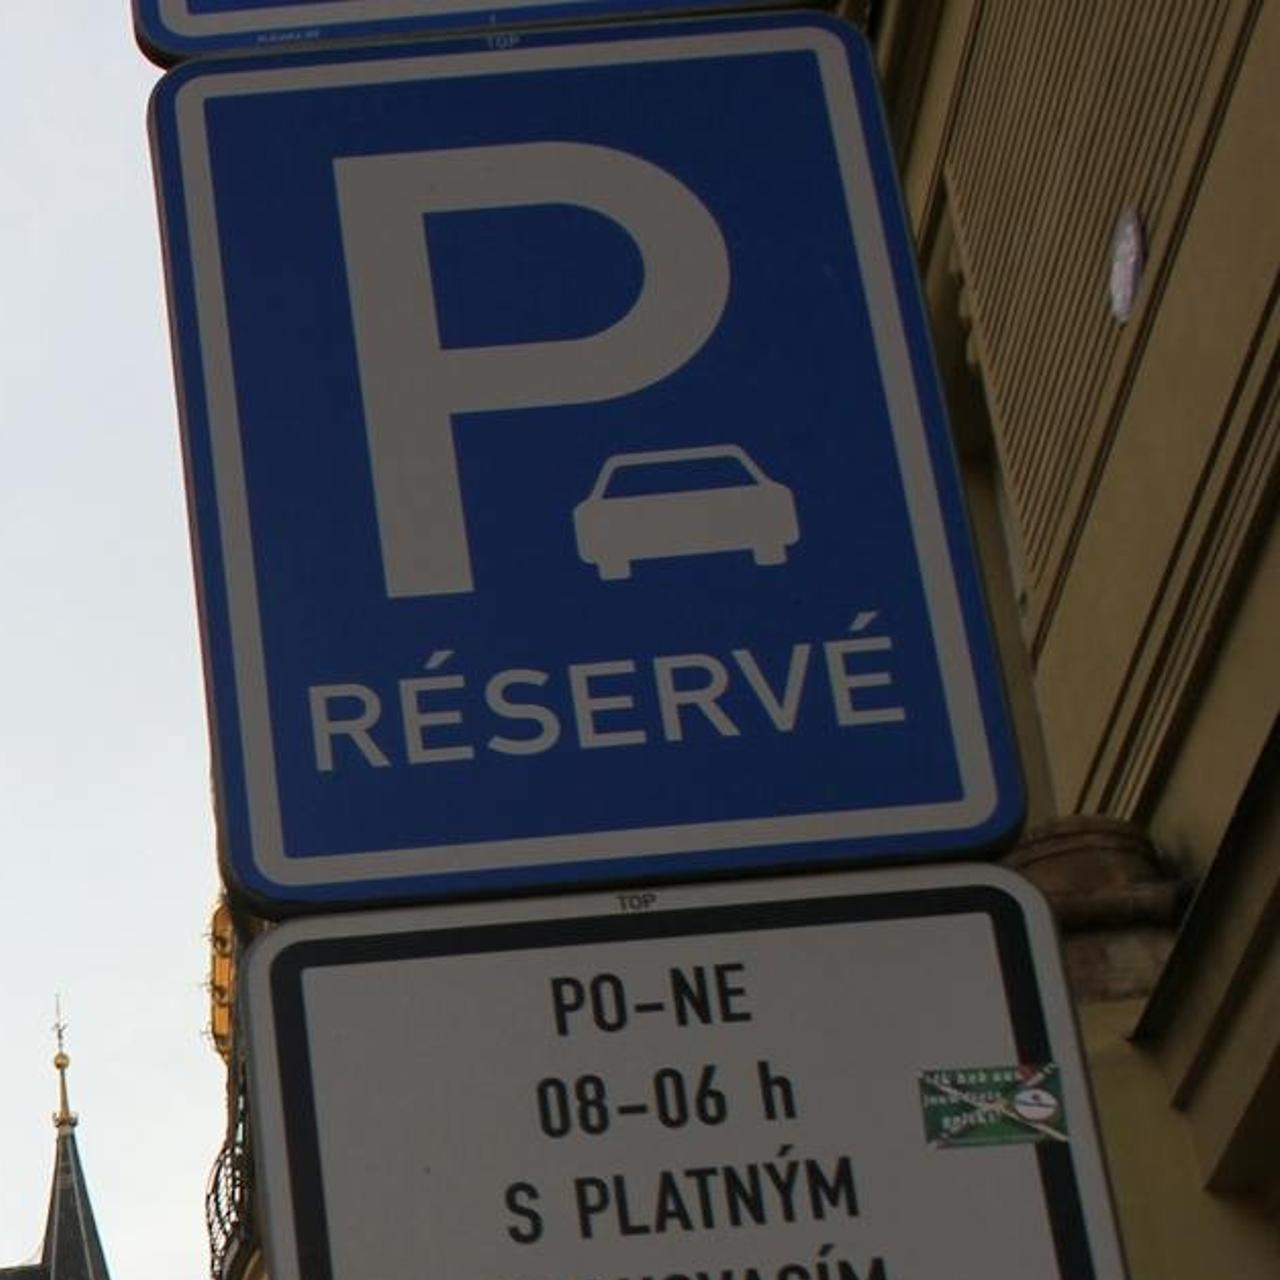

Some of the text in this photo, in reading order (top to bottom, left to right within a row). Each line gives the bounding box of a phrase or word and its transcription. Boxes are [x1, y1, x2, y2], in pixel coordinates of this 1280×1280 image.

[332, 141, 731, 599] P
[308, 611, 906, 772] RÉSERVÉ
[616, 893, 657, 910] TOP
[536, 1060, 797, 1139] 08-06 h
[505, 1143, 860, 1245] S PLATNÝM
